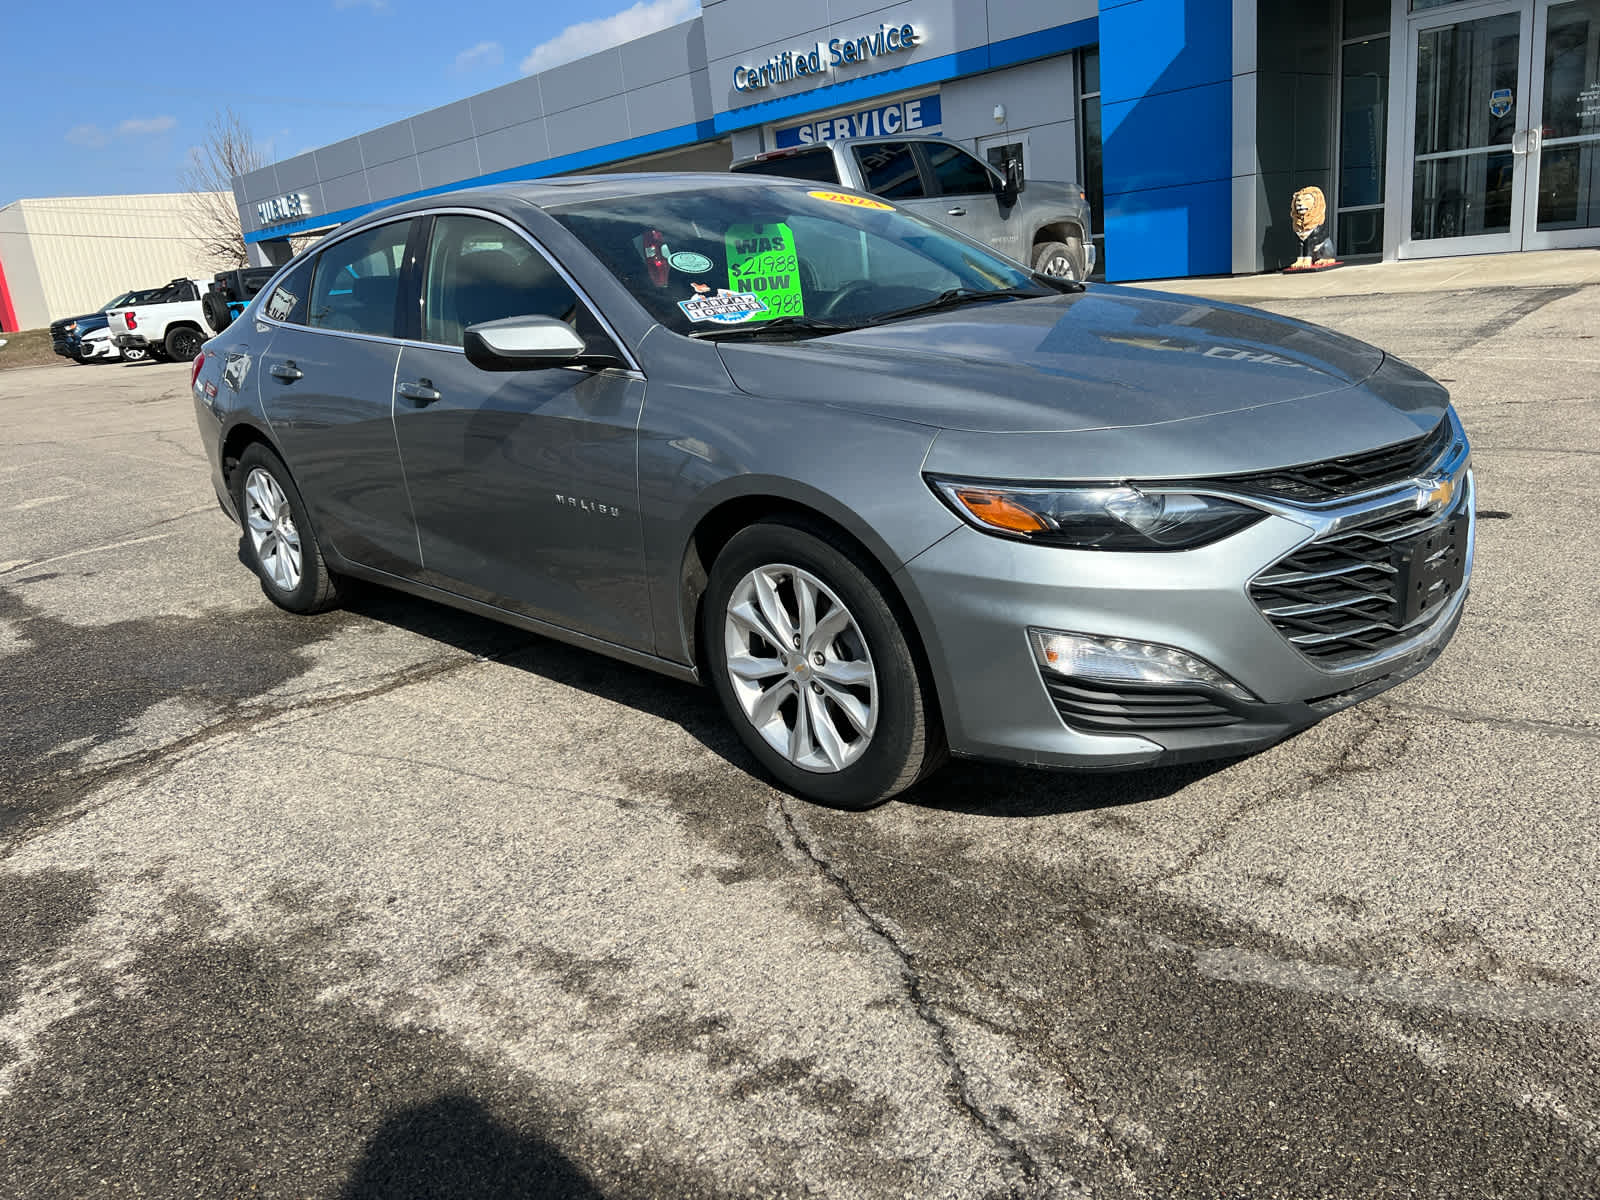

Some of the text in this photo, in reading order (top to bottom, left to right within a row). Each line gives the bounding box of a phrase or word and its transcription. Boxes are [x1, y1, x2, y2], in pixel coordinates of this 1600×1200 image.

[733, 23, 914, 92] Certified Service
[799, 101, 923, 145] SERVICE
[735, 236, 786, 254] WAS
[738, 275, 790, 293] NOW
[685, 297, 758, 310] CARFAX
[555, 494, 619, 517] MALIBU
